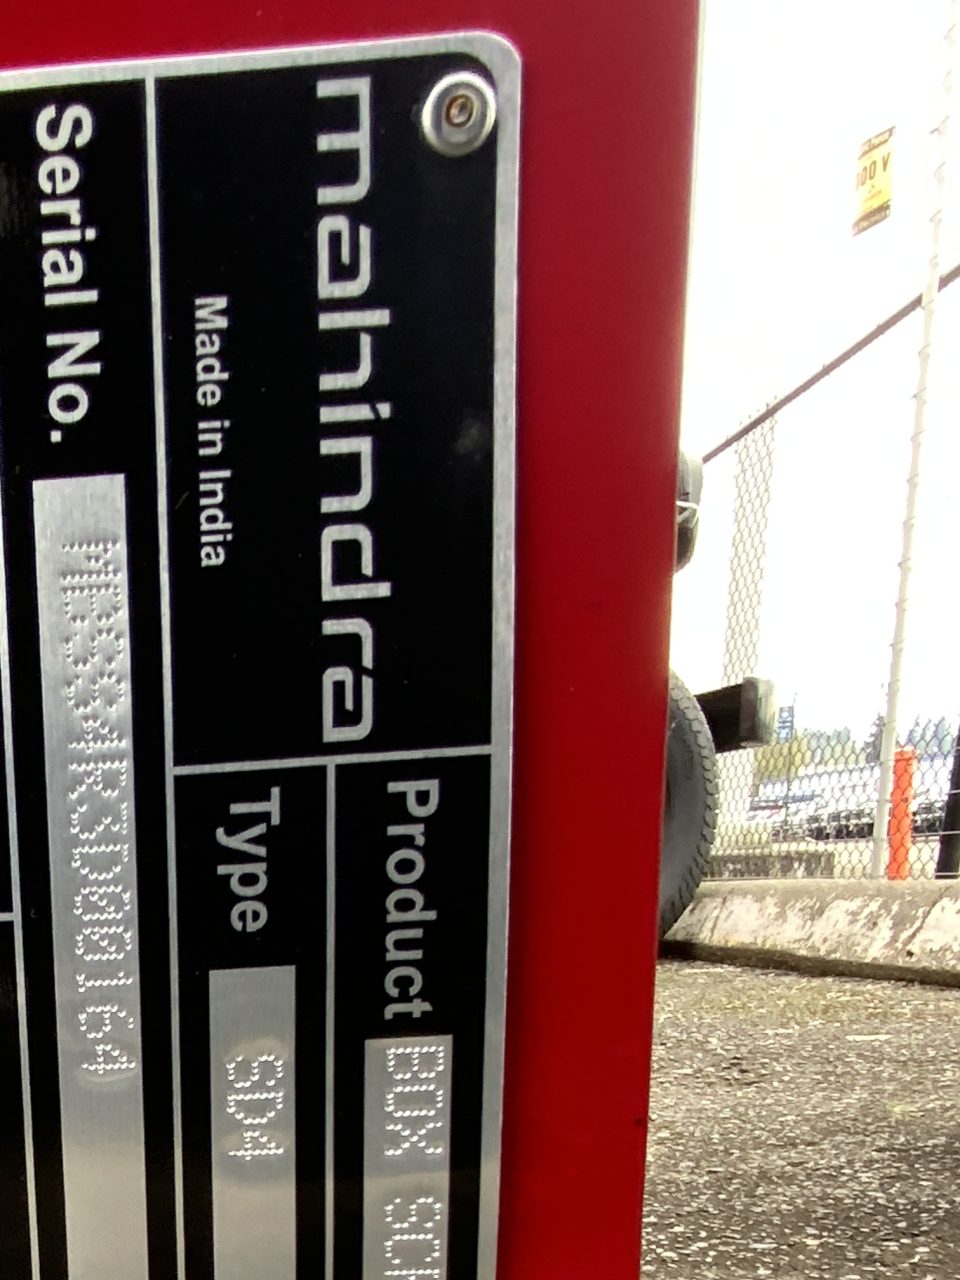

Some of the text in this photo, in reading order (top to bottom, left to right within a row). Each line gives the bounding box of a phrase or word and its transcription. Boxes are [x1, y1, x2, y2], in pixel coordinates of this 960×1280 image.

[36, 104, 99, 306] Serial
[46, 331, 102, 443] No.
[194, 296, 233, 567] Made in India
[317, 76, 391, 743] mahindra
[215, 786, 286, 1163] Type SD4
[384, 779, 440, 1020] Product
[384, 1045, 445, 1157] BOX
